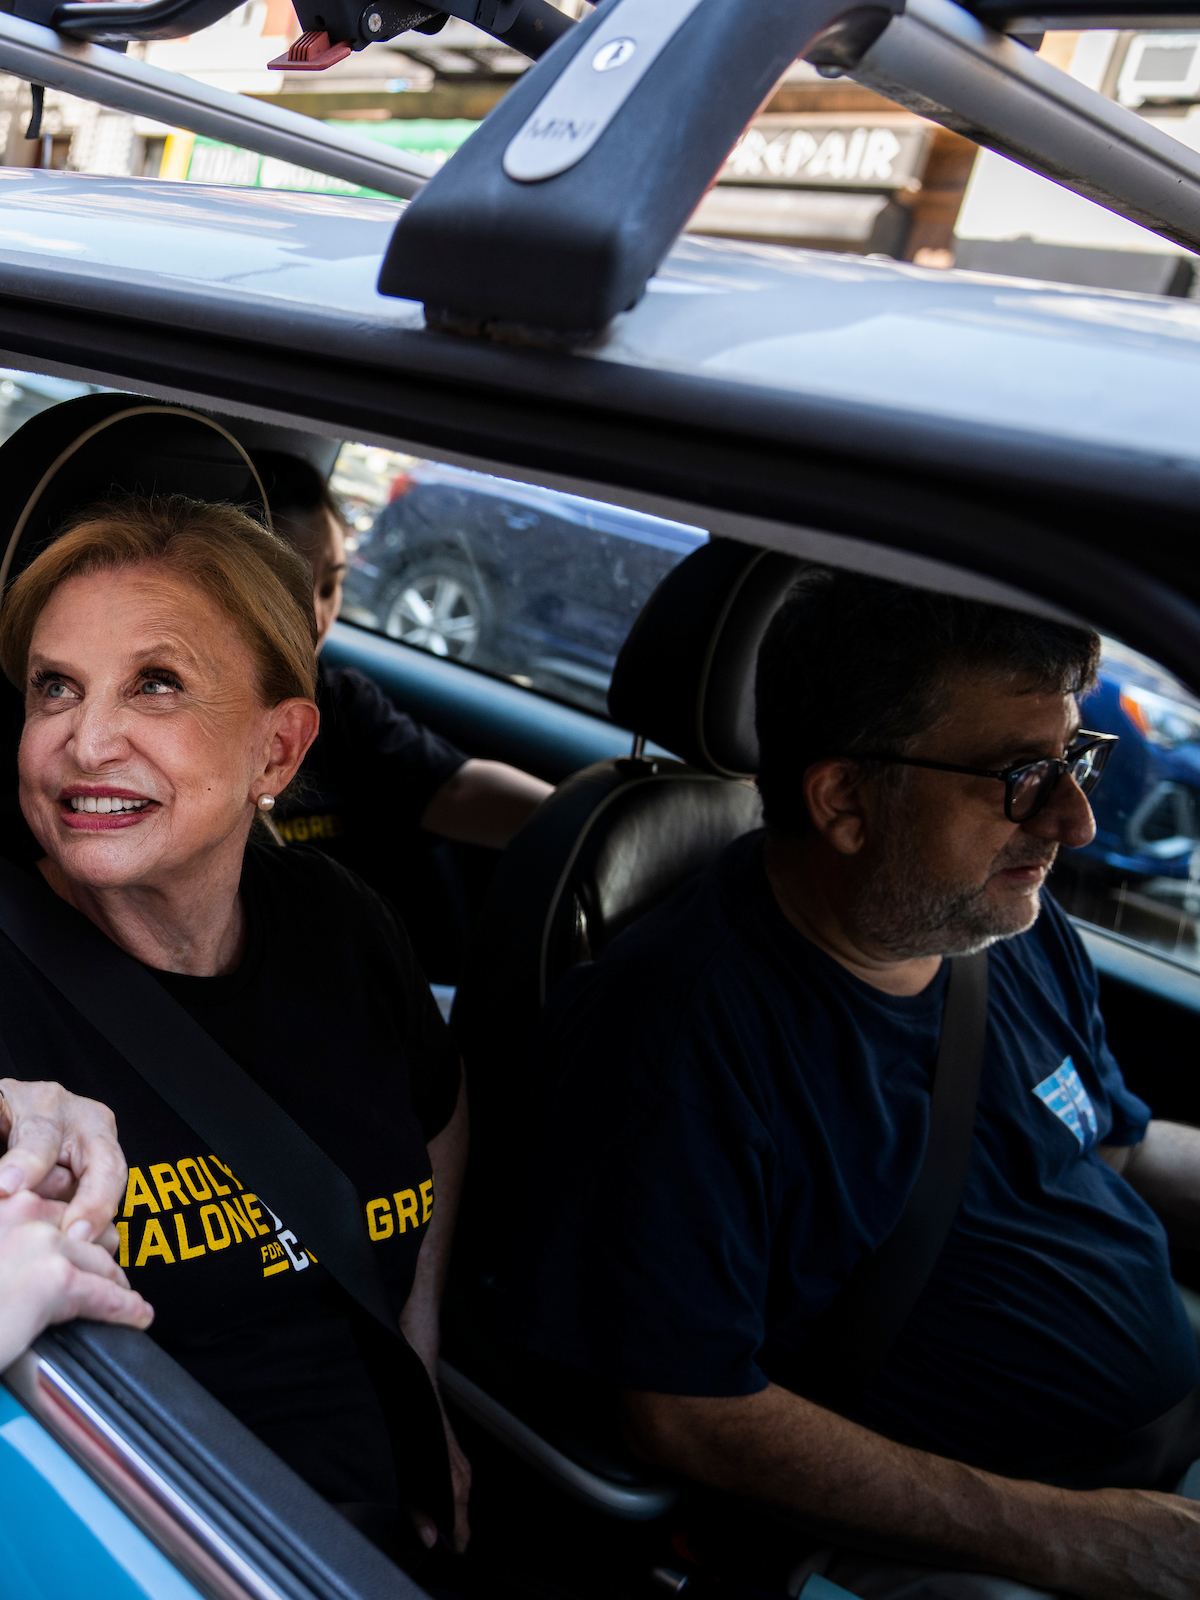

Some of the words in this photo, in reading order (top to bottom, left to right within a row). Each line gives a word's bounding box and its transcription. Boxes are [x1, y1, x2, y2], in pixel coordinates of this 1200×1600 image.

[522, 117, 598, 141] MINI
[115, 1154, 244, 1218] AROLY
[115, 1193, 271, 1268] ALONE
